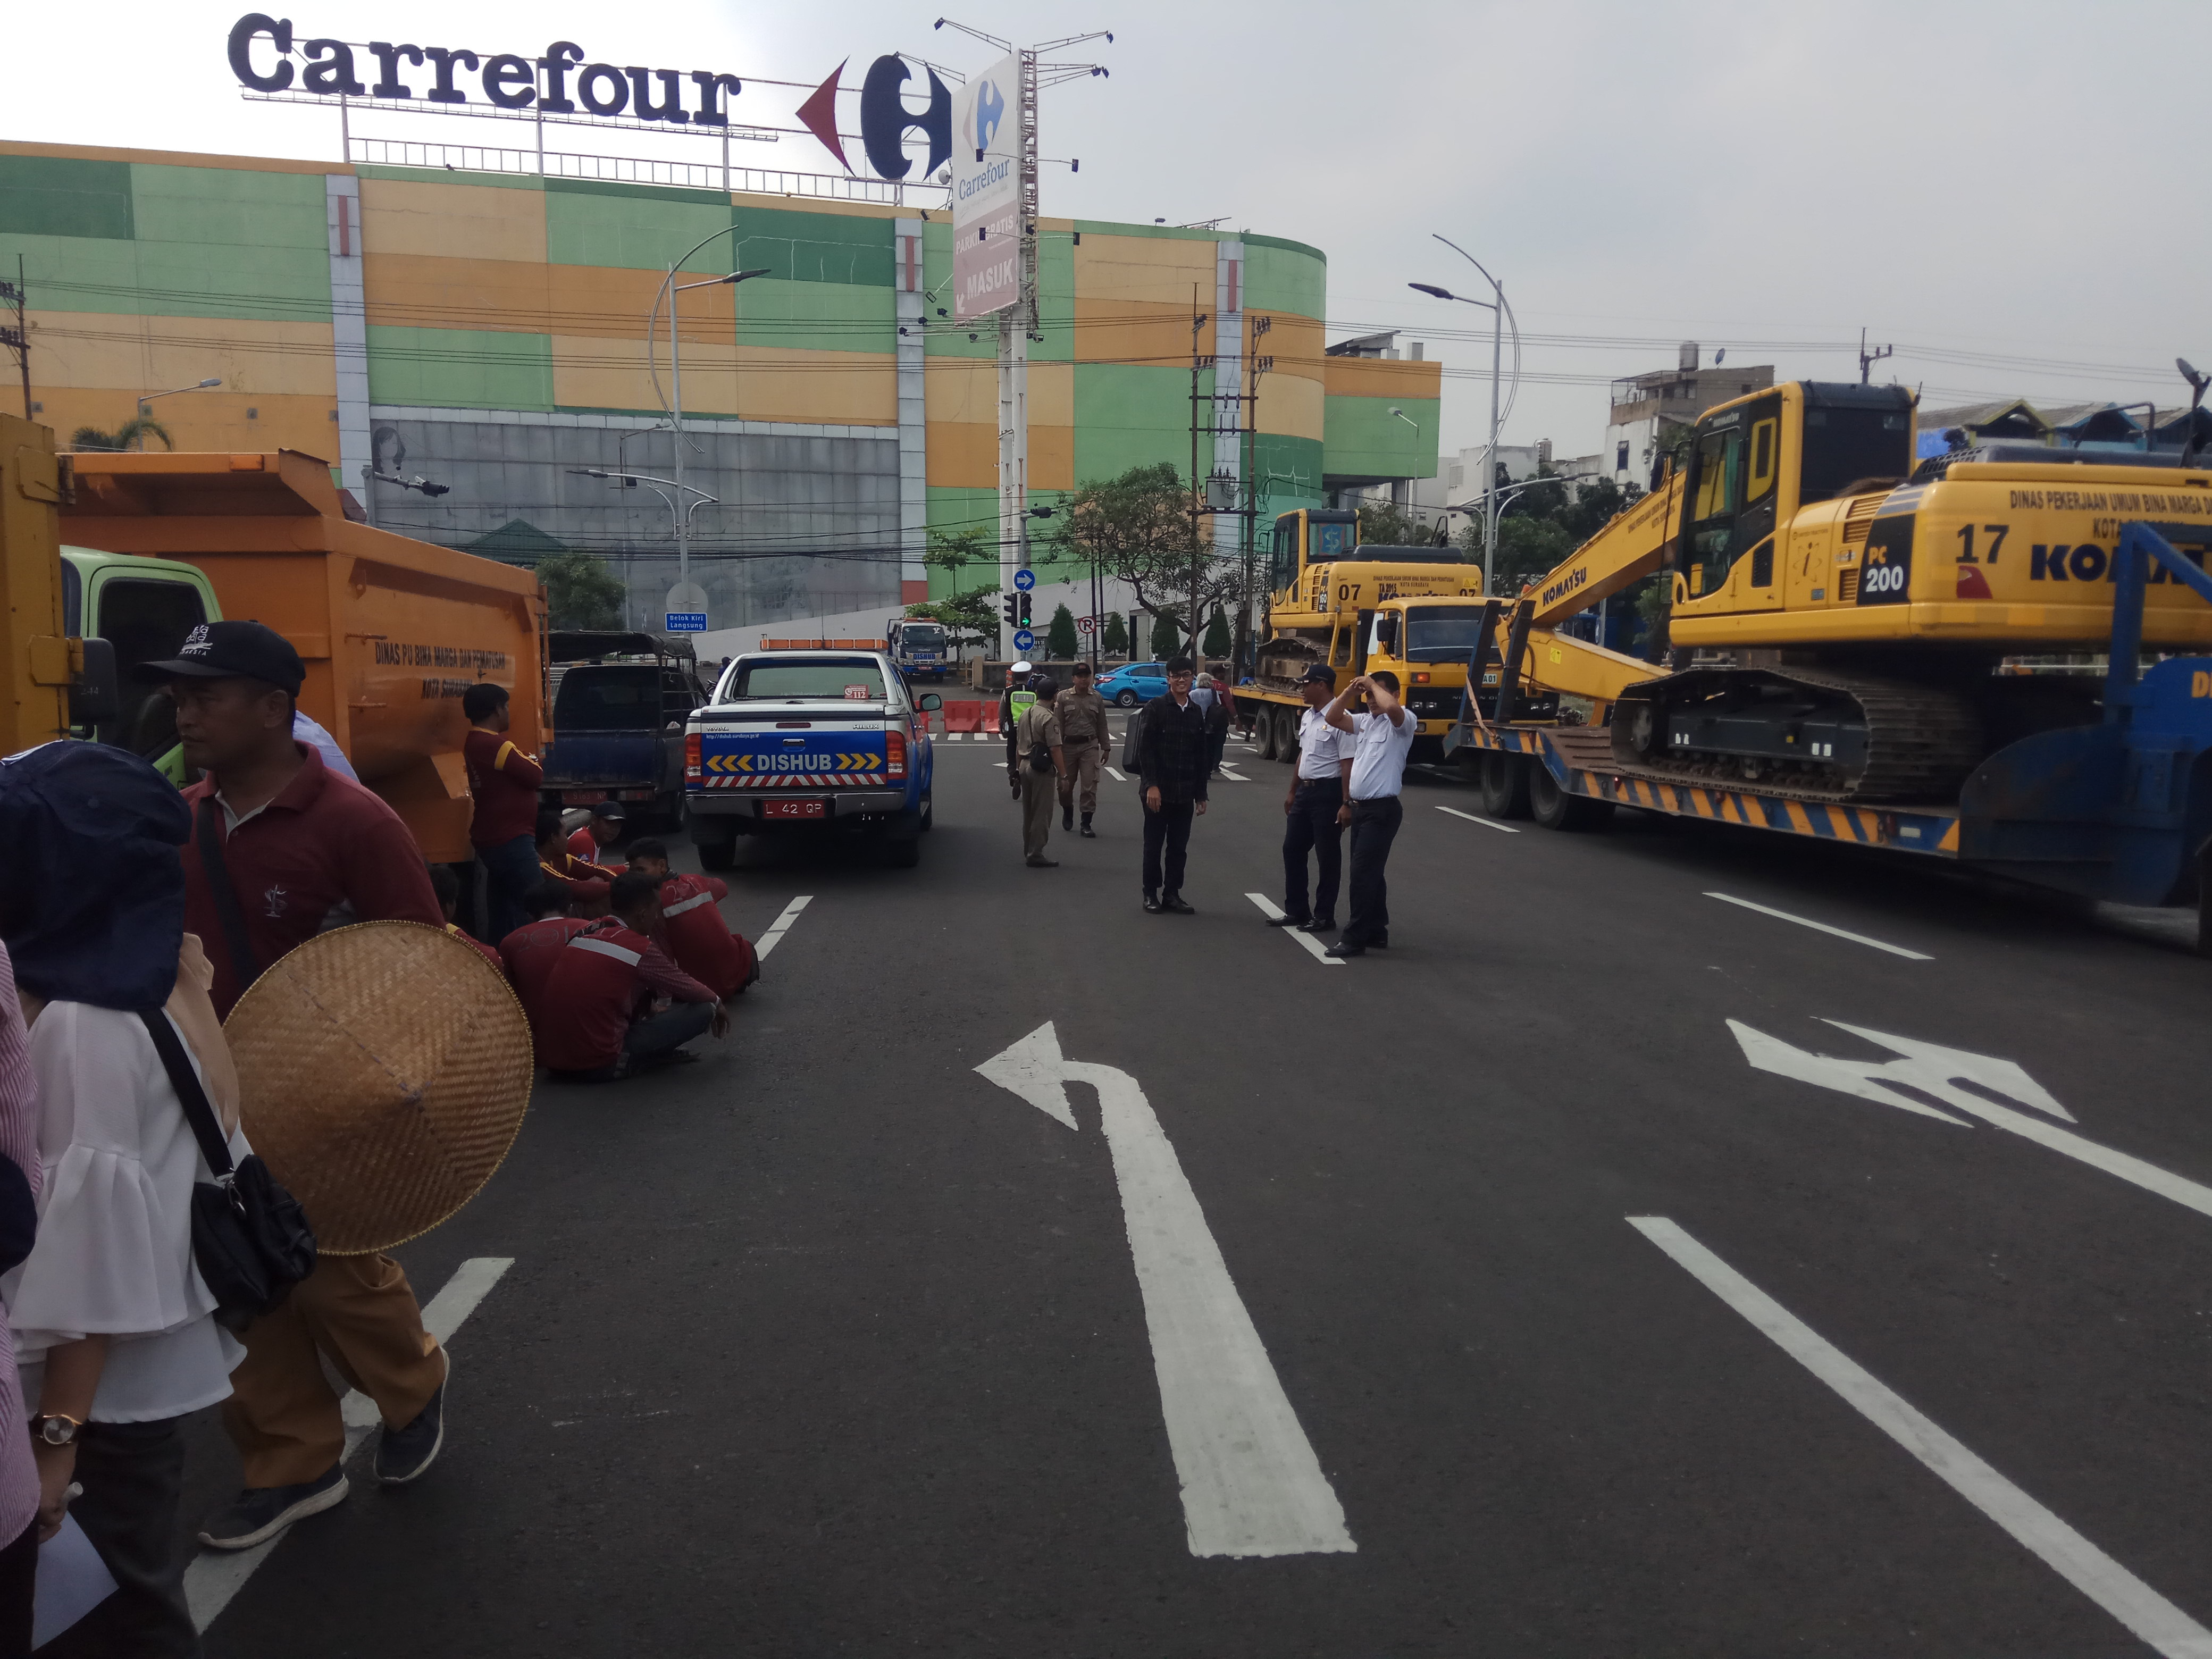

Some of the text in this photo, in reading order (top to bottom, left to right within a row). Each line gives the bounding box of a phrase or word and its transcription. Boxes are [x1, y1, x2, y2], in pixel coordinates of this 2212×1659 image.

[227, 13, 741, 127] Carrefour
[959, 159, 1009, 200] Carrefour
[957, 230, 983, 255] PARKI
[985, 214, 1013, 240] GRATIS
[968, 258, 1013, 300] MASUK
[2010, 490, 2043, 509] DINAS
[2047, 491, 2108, 511] PEKERJAAN
[2110, 493, 2141, 513] UMUM
[2143, 494, 2167, 513] BINA
[2168, 496, 2203, 514] MARGA
[1869, 546, 1887, 565] PC
[1956, 524, 2009, 564] 17
[1379, 583, 1385, 592] TA
[1543, 566, 1587, 607] KOMATSU
[1866, 565, 1904, 592] 200
[1338, 584, 1361, 601] 07
[375, 642, 400, 665] DINAS
[402, 644, 413, 666] PU
[415, 644, 432, 666] BINA
[422, 678, 439, 699] KOTA
[757, 754, 832, 771] DISHUB
[766, 803, 822, 814] L 42 QP
